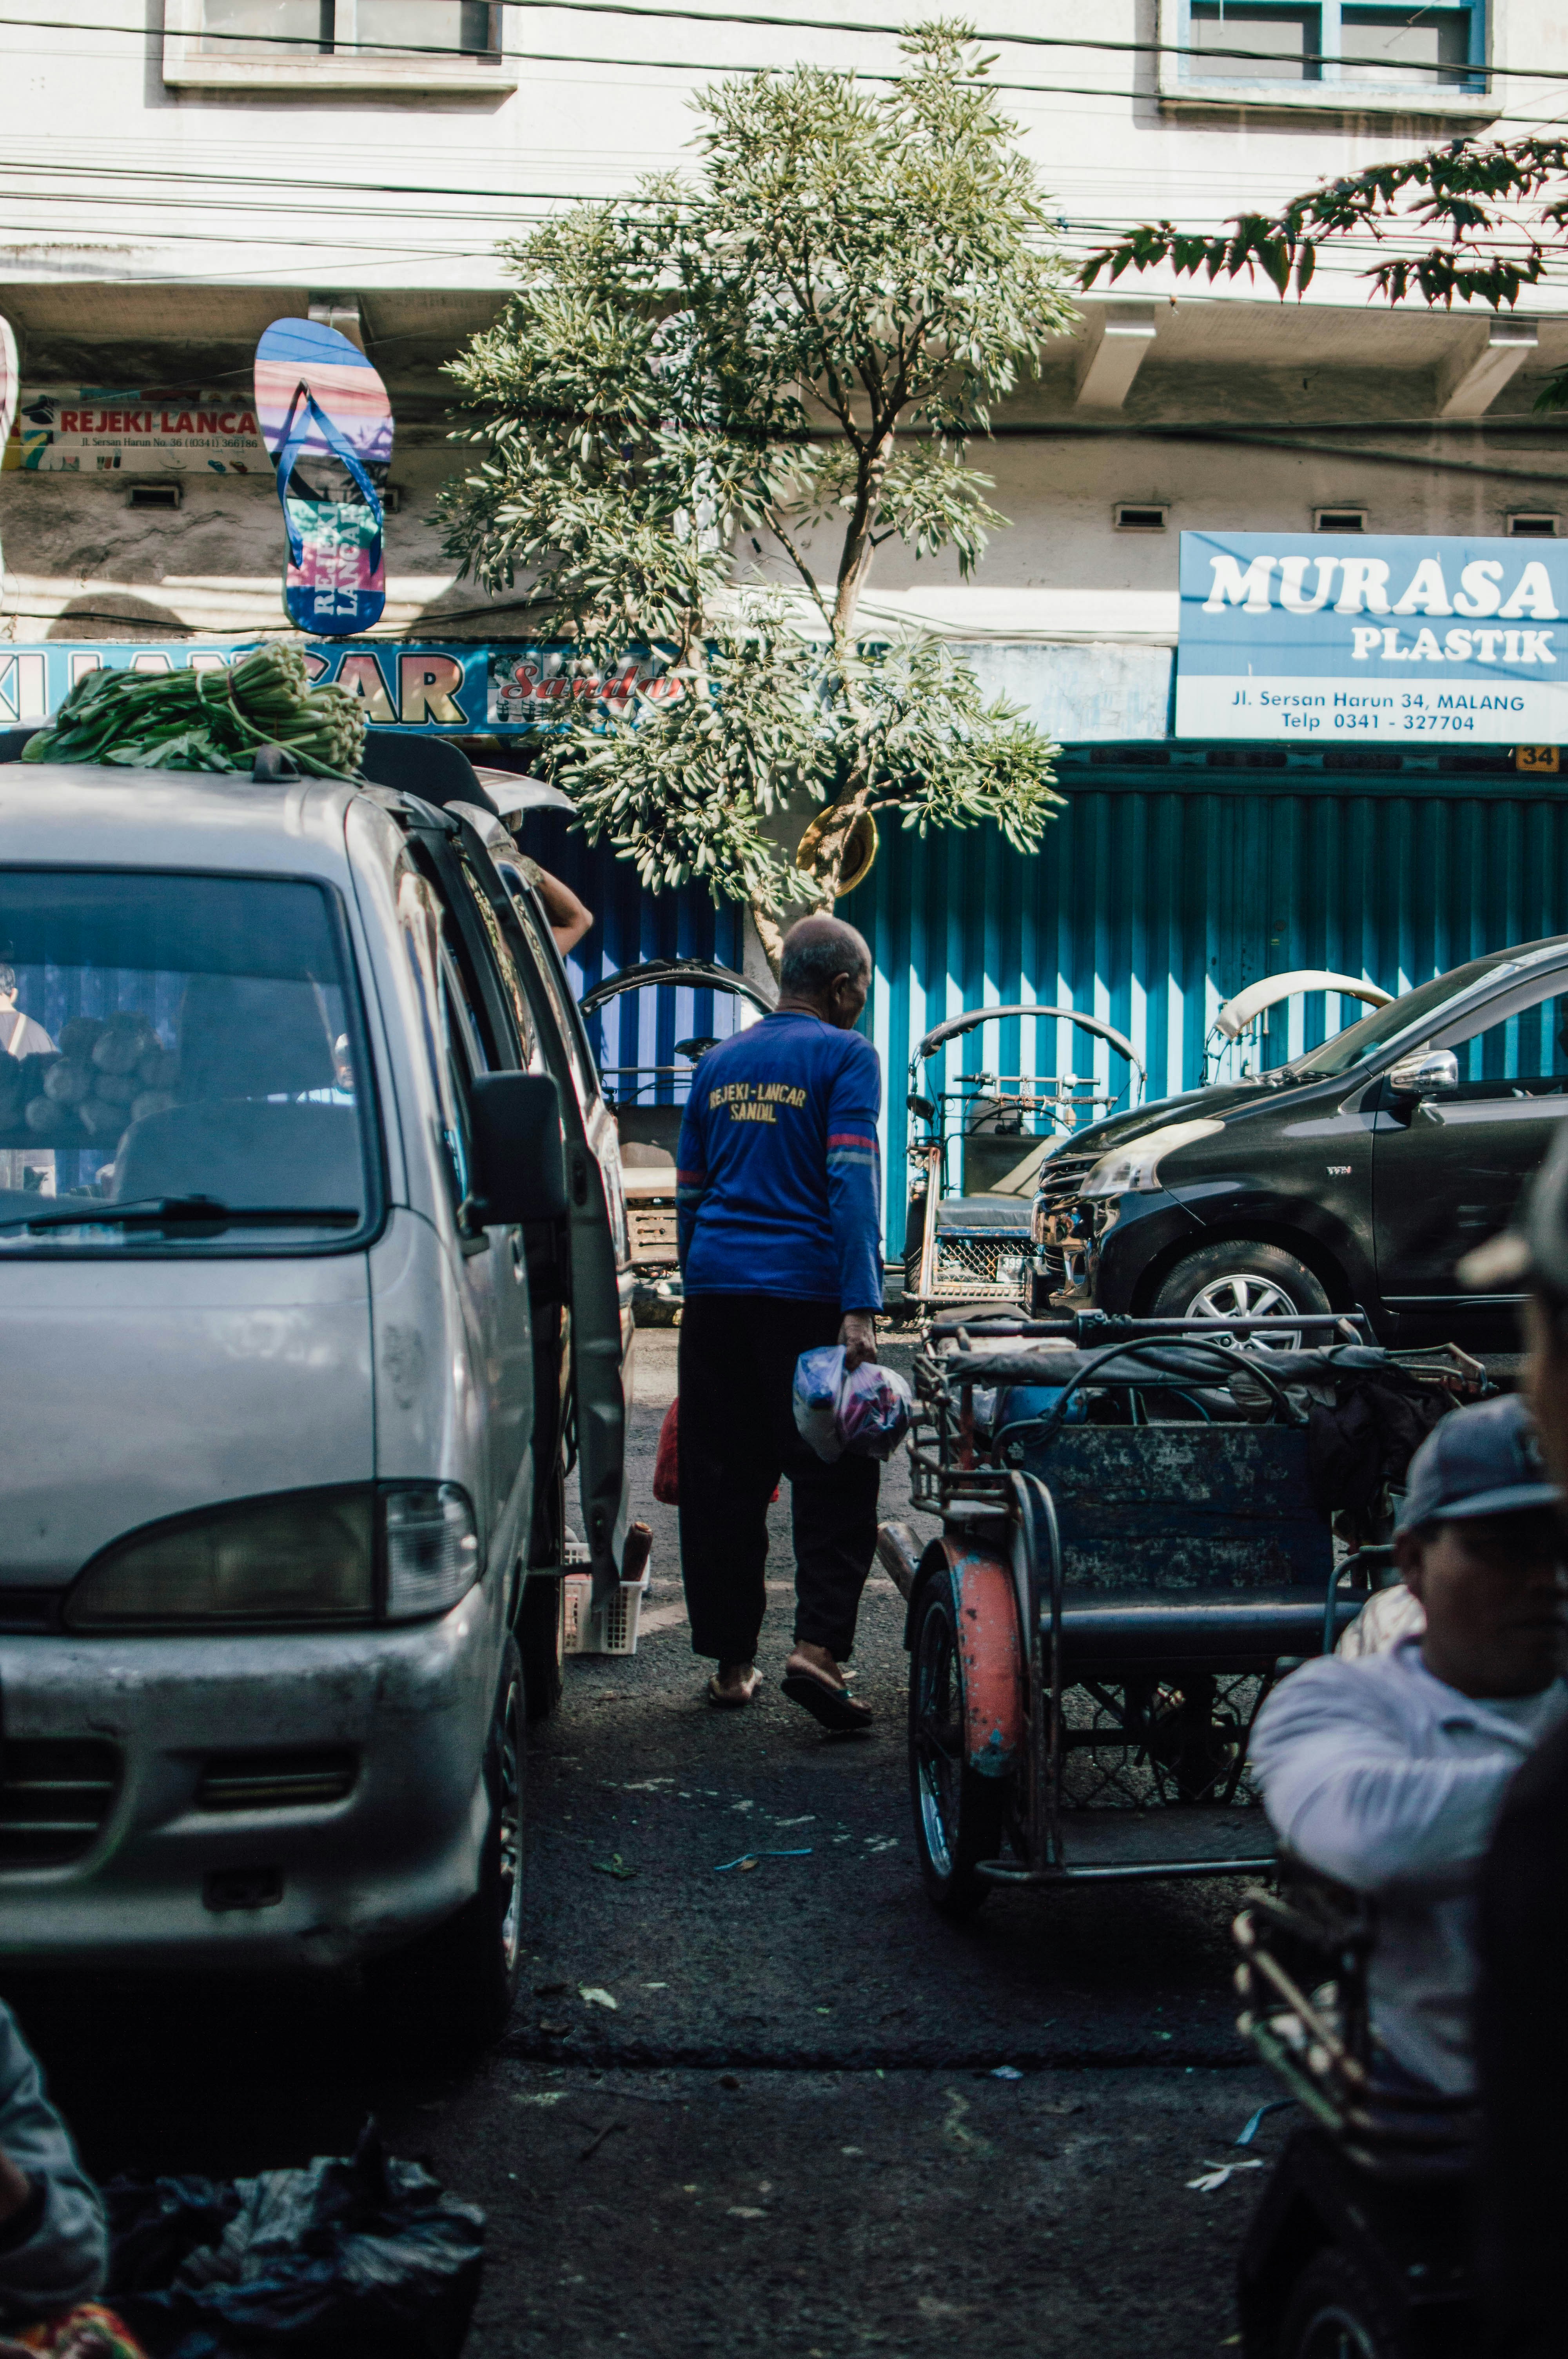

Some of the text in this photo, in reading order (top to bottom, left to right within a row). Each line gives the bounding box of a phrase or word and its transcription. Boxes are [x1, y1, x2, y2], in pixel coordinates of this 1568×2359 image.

[61, 411, 152, 432] REJEKI
[93, 438, 121, 446] Sersan
[124, 438, 151, 446] Harun
[222, 439, 258, 447] 366186
[314, 503, 339, 615] REJEKI
[1202, 556, 1559, 619] MURASA
[1352, 628, 1556, 663] PLASTIK
[1232, 690, 1524, 711] Jl. Sersan Harun 34, MALANG
[1282, 712, 1320, 731] Telp
[1334, 714, 1378, 728] 0341
[1403, 715, 1474, 730] 327704
[1523, 747, 1553, 765] 34
[1002, 1257, 1023, 1269] 399
